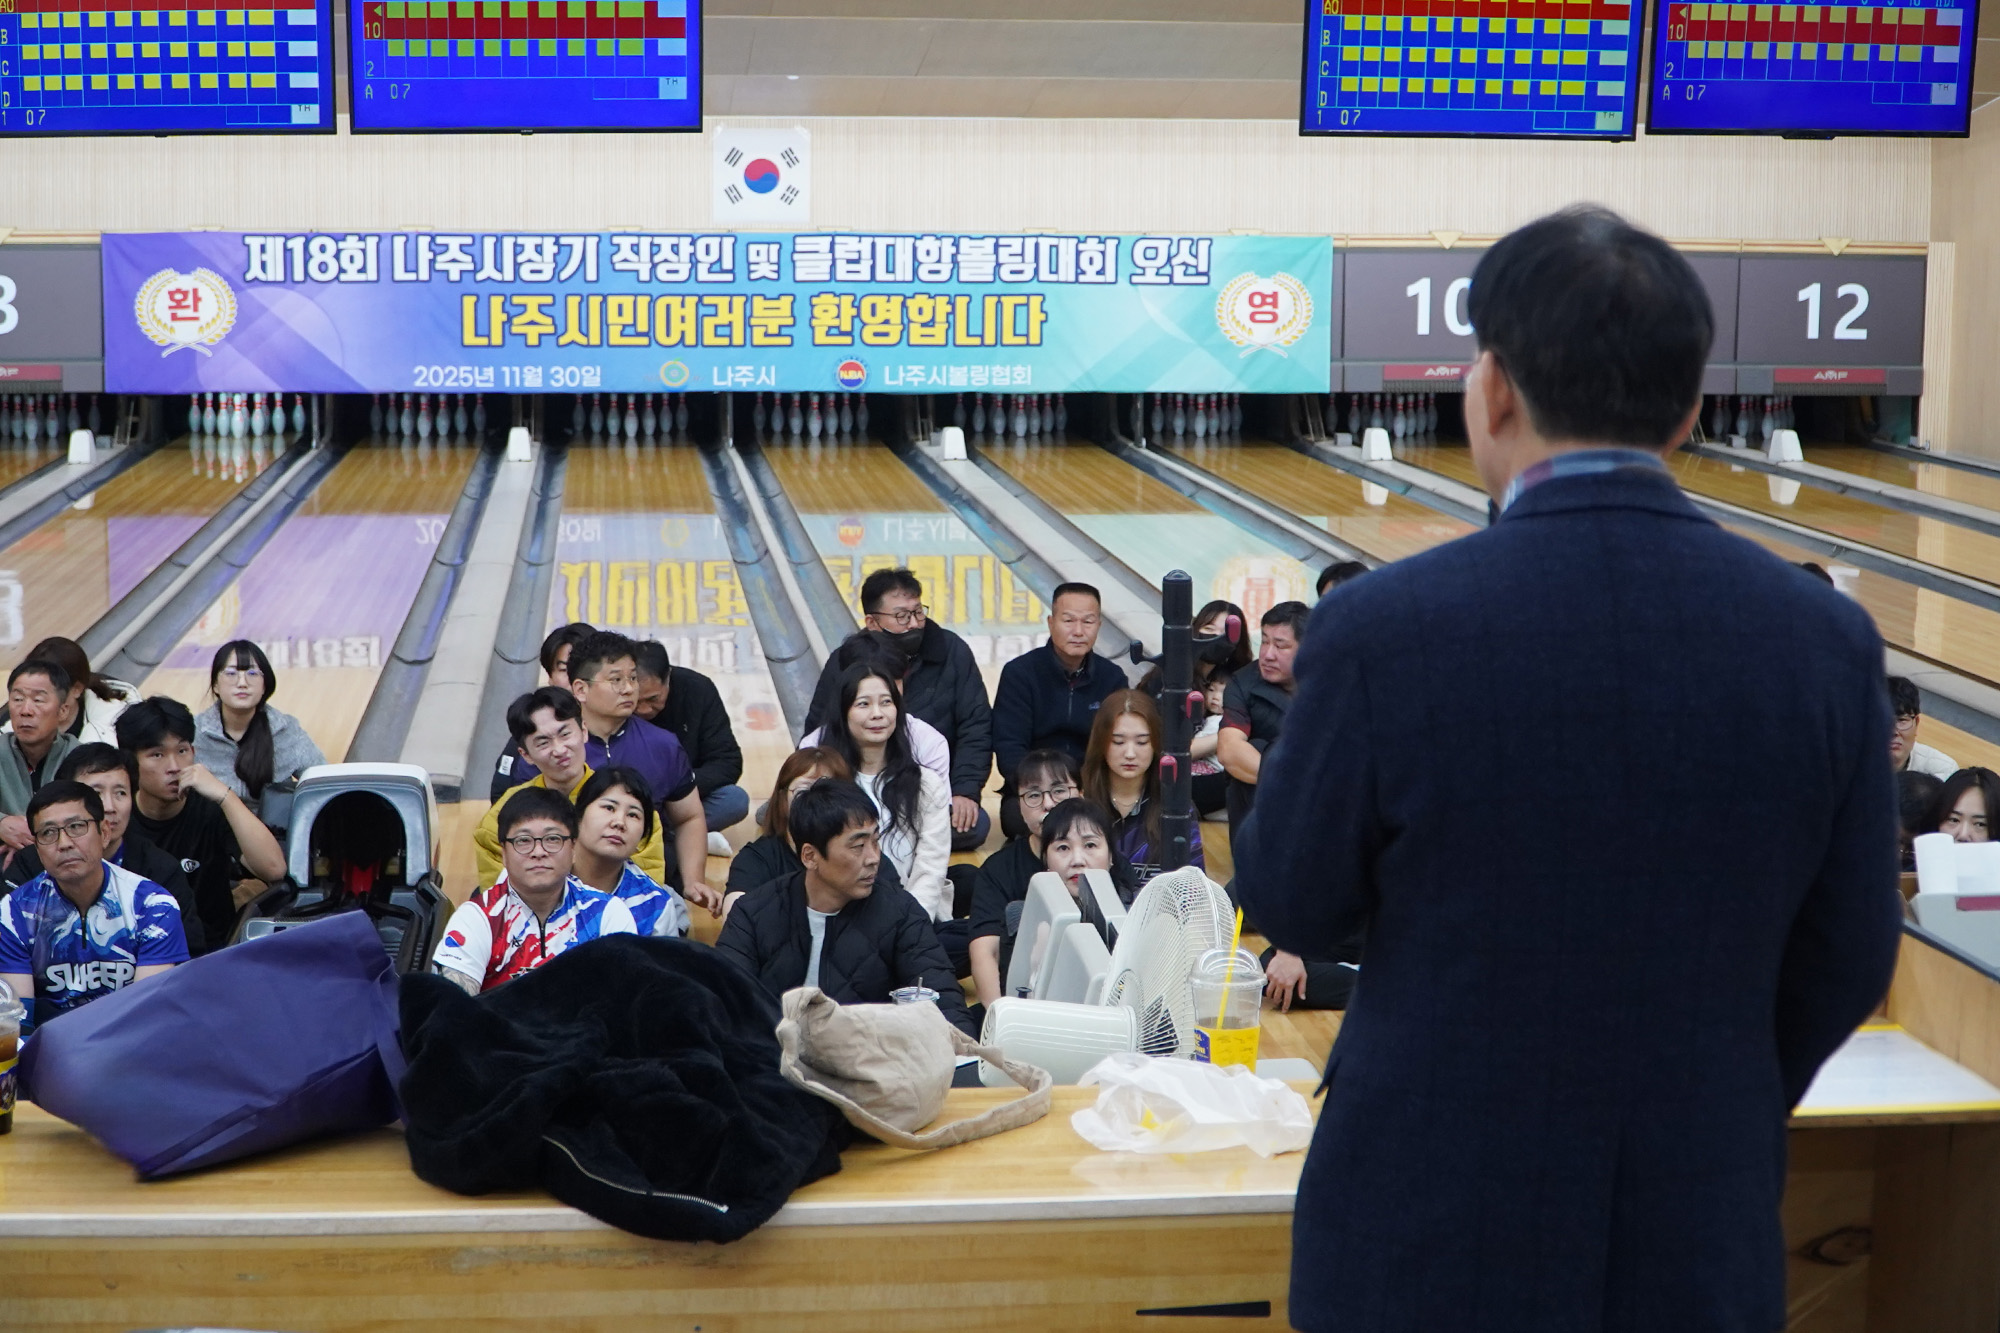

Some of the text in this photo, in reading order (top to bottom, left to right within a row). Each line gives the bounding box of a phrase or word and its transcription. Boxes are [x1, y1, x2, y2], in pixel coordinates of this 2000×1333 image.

[1, 29, 8, 44] B
[364, 22, 381, 39] 10
[1323, 30, 1330, 45] B
[1669, 24, 1684, 40] 10
[2, 60, 9, 76] C
[366, 61, 374, 77] 2
[1321, 61, 1329, 76] C
[1665, 62, 1674, 78] 2
[3, 91, 10, 107] D
[365, 84, 411, 100] A 07
[1320, 91, 1327, 107] D
[1663, 85, 1706, 100] A 07
[26, 109, 45, 125] 07
[1340, 110, 1361, 125] 07
[243, 234, 1213, 287] 제18회 나주시장기 직장인 및 클럽대항볼링대회 오신
[166, 286, 202, 323] 환
[1247, 289, 1280, 324] 영
[1797, 282, 1869, 340] 12
[460, 292, 1049, 349] 나주시민여러분 환영합니다
[413, 365, 602, 388] 2025년 11월 30일
[712, 364, 776, 388] 나주시
[883, 364, 1032, 388] 나주시볼링협회
[1424, 366, 1461, 377] AMF
[1813, 369, 1849, 381] AMF
[45, 961, 135, 992] SWEEP
